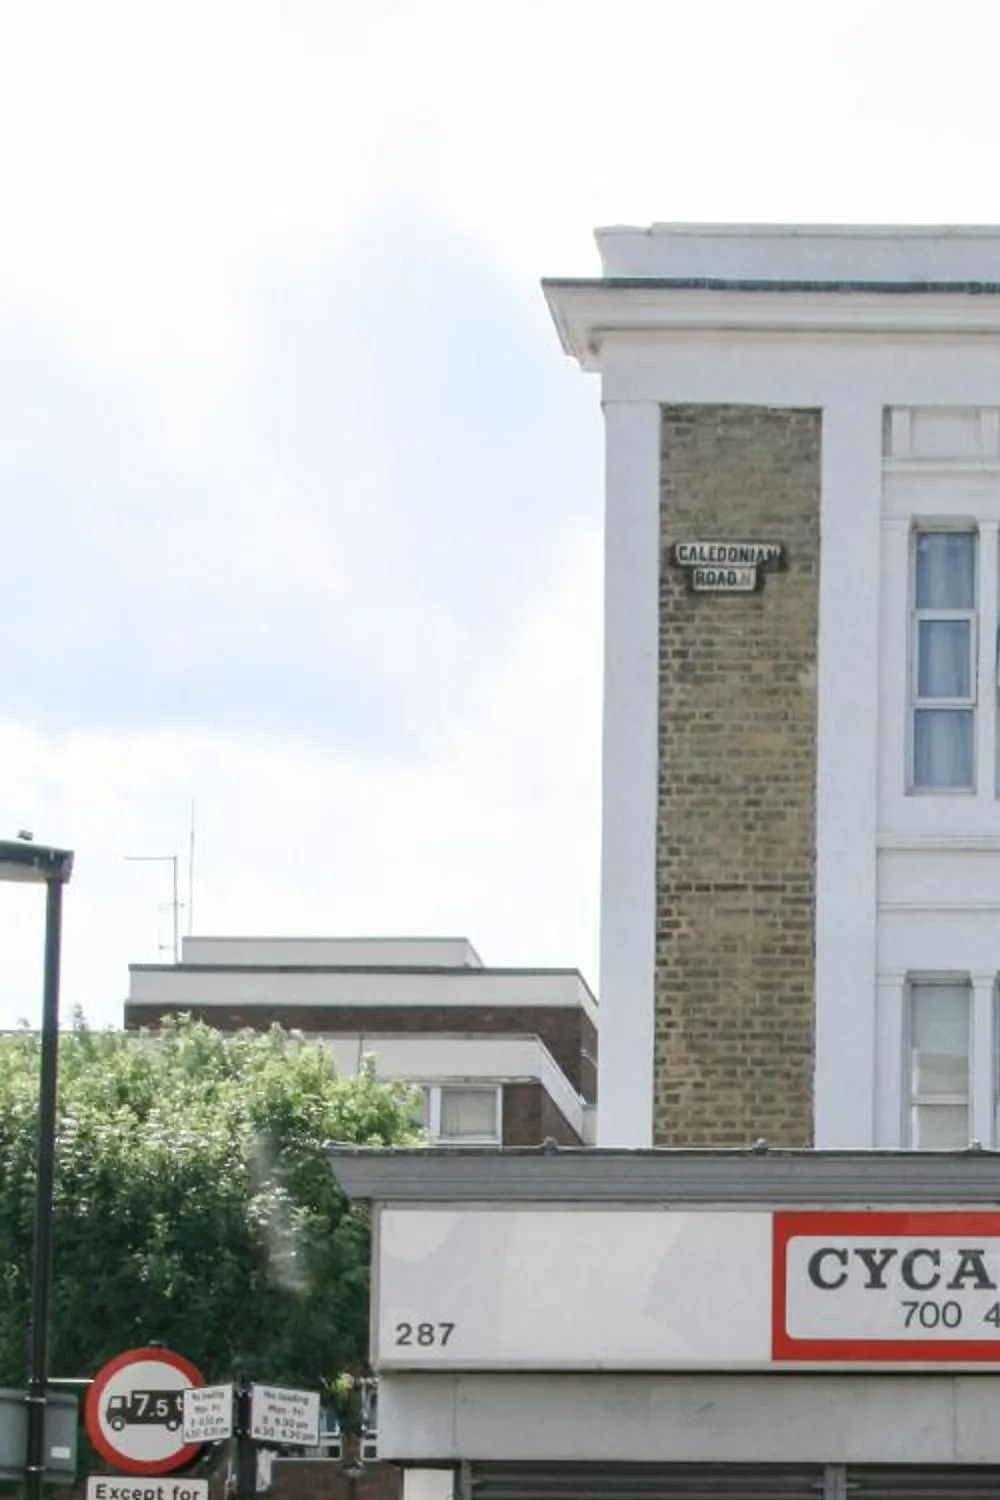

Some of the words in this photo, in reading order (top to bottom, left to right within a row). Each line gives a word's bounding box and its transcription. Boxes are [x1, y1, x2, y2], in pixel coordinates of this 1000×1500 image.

[679, 545, 777, 562] CALEDONIAN
[696, 571, 737, 586] ROAD
[807, 1248, 997, 1291] CYCA
[902, 1301, 962, 1329] 700
[395, 1322, 456, 1347] 287
